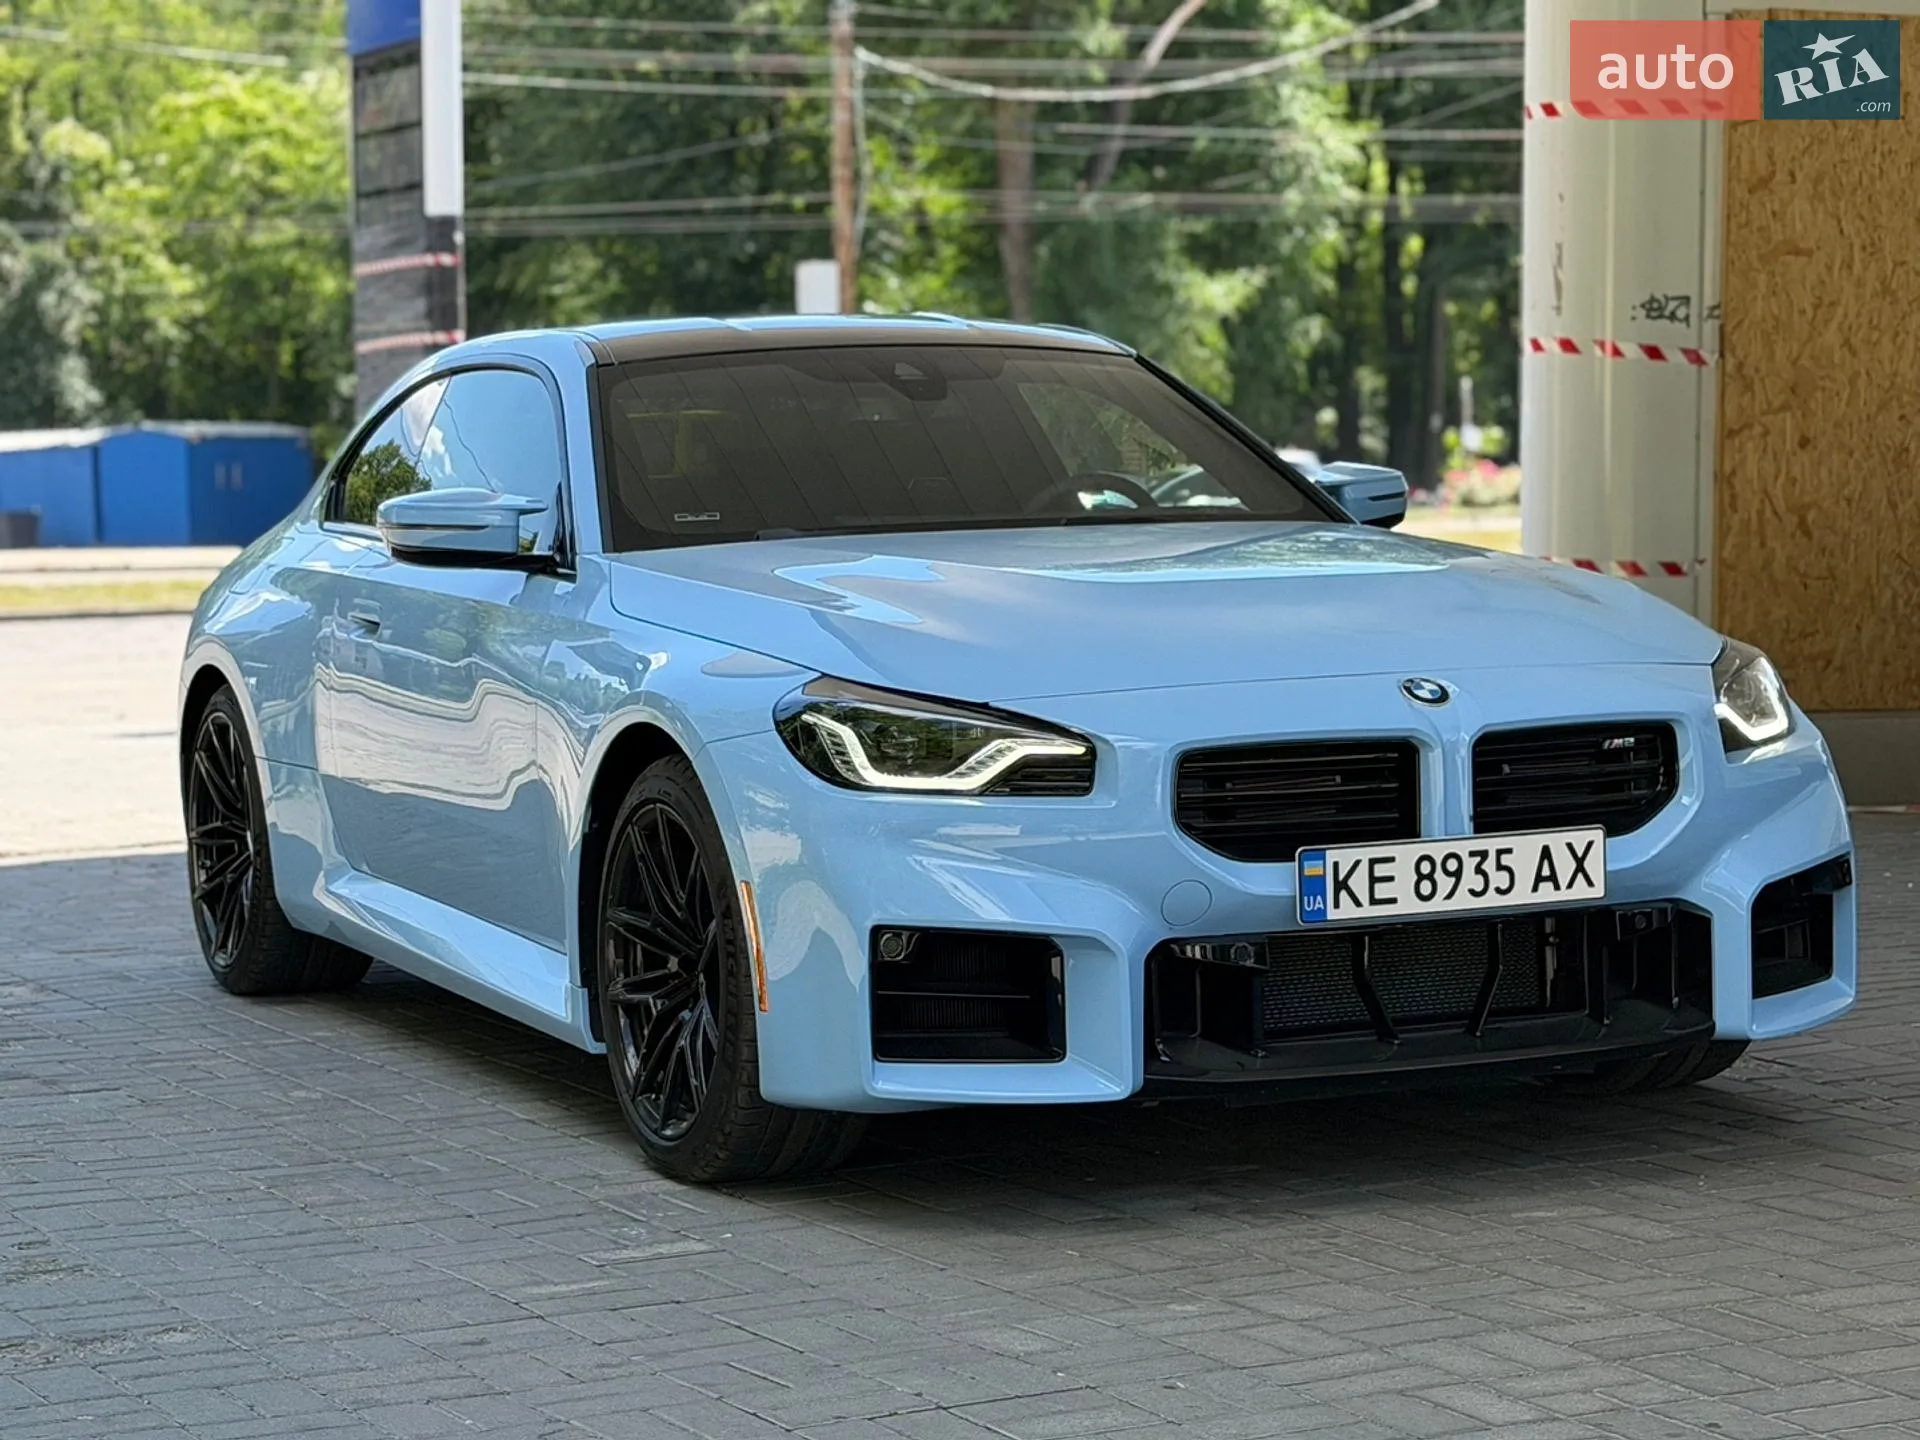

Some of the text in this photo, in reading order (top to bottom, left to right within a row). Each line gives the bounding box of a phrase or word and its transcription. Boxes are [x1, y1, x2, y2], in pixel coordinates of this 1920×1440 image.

[1333, 840, 1595, 910] KE 8935 AX
[1303, 895, 1325, 911] UA
